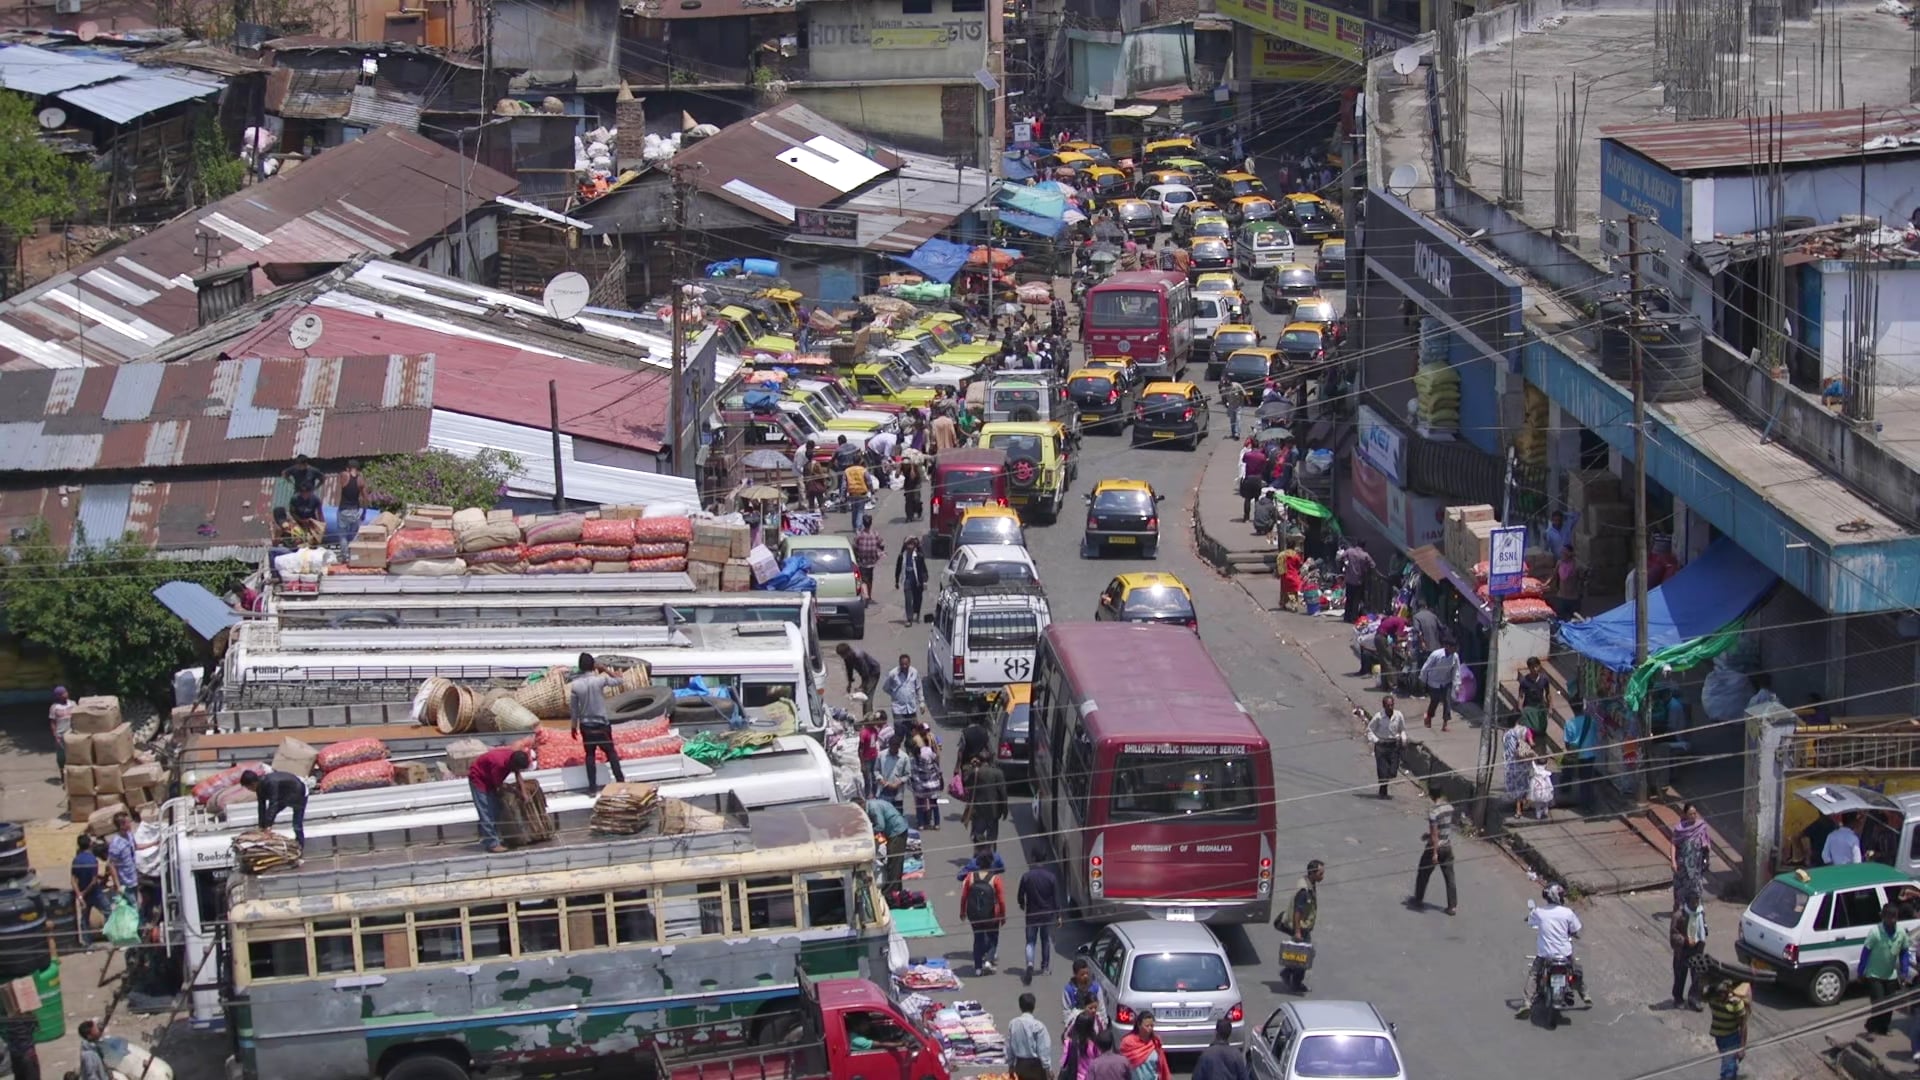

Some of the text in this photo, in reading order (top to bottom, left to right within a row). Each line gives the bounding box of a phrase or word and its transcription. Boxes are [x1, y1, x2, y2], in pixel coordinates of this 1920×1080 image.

[810, 22, 870, 46] HOTEL
[1414, 239, 1452, 298] KOHLER
[1370, 424, 1389, 453] KEI
[1500, 551, 1518, 561] BSNL
[1124, 744, 1246, 754] SHILLONG PUBLIC TRANSPORT SERVICE
[1131, 844, 1172, 852] GOVERNMENT
[1179, 845, 1189, 853] OF
